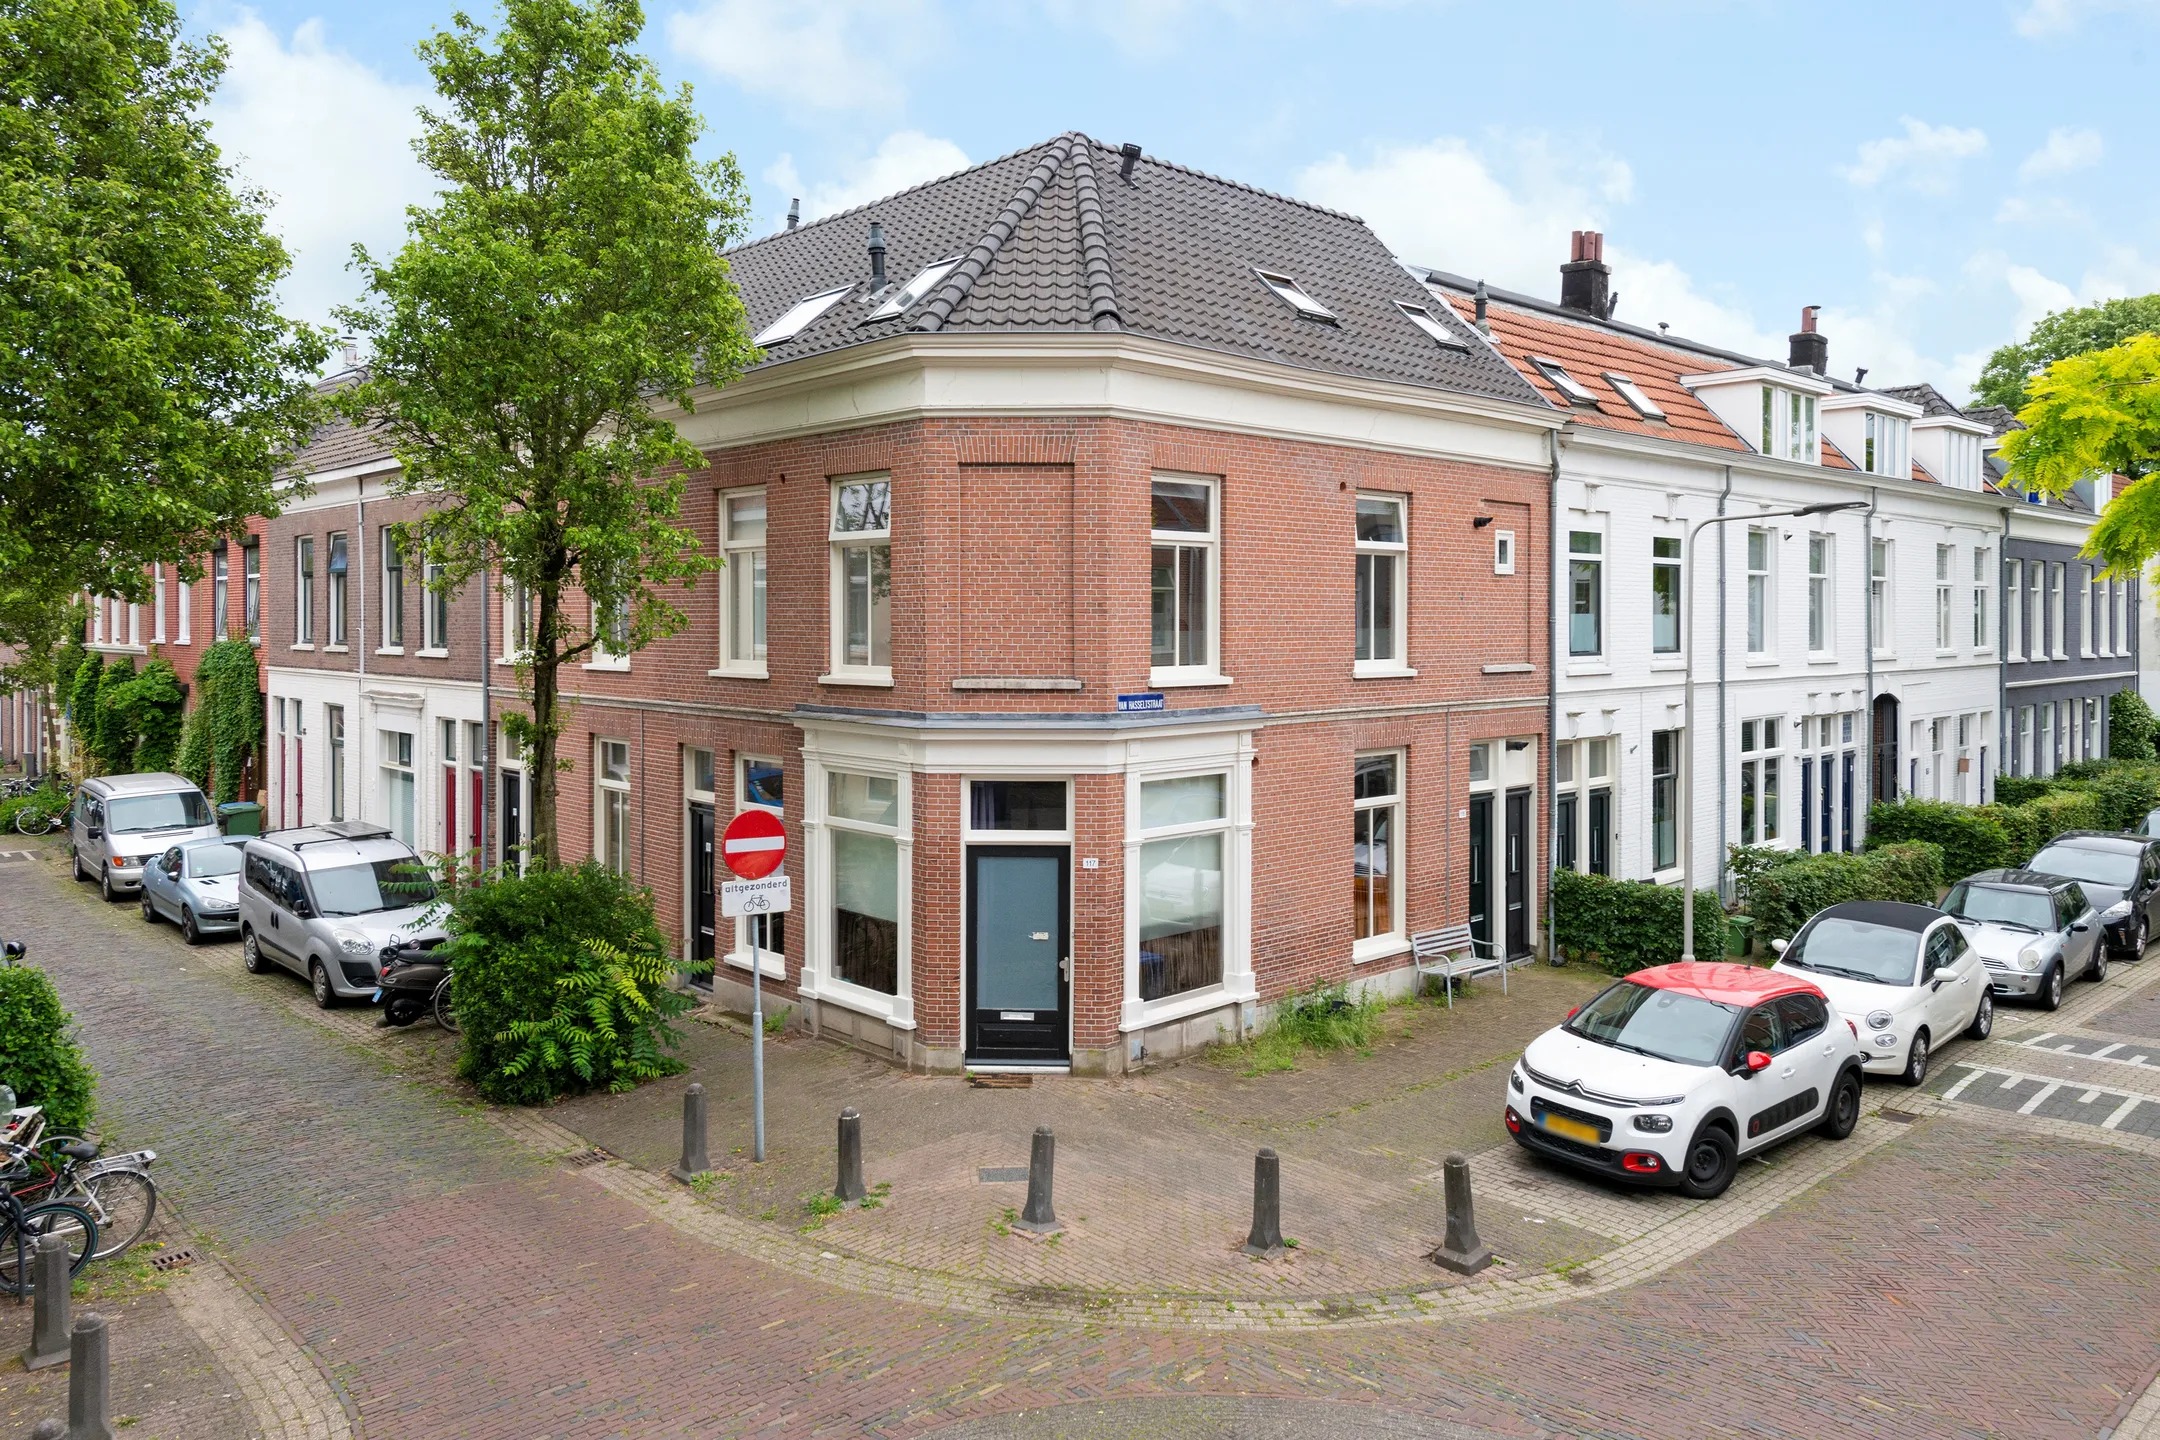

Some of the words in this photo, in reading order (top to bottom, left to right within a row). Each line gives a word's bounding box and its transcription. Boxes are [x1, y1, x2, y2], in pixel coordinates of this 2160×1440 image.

[1118, 701, 1128, 710] VAN
[1128, 699, 1163, 710] HASSELTSTRAAT
[725, 880, 788, 894] uitgezonderd
